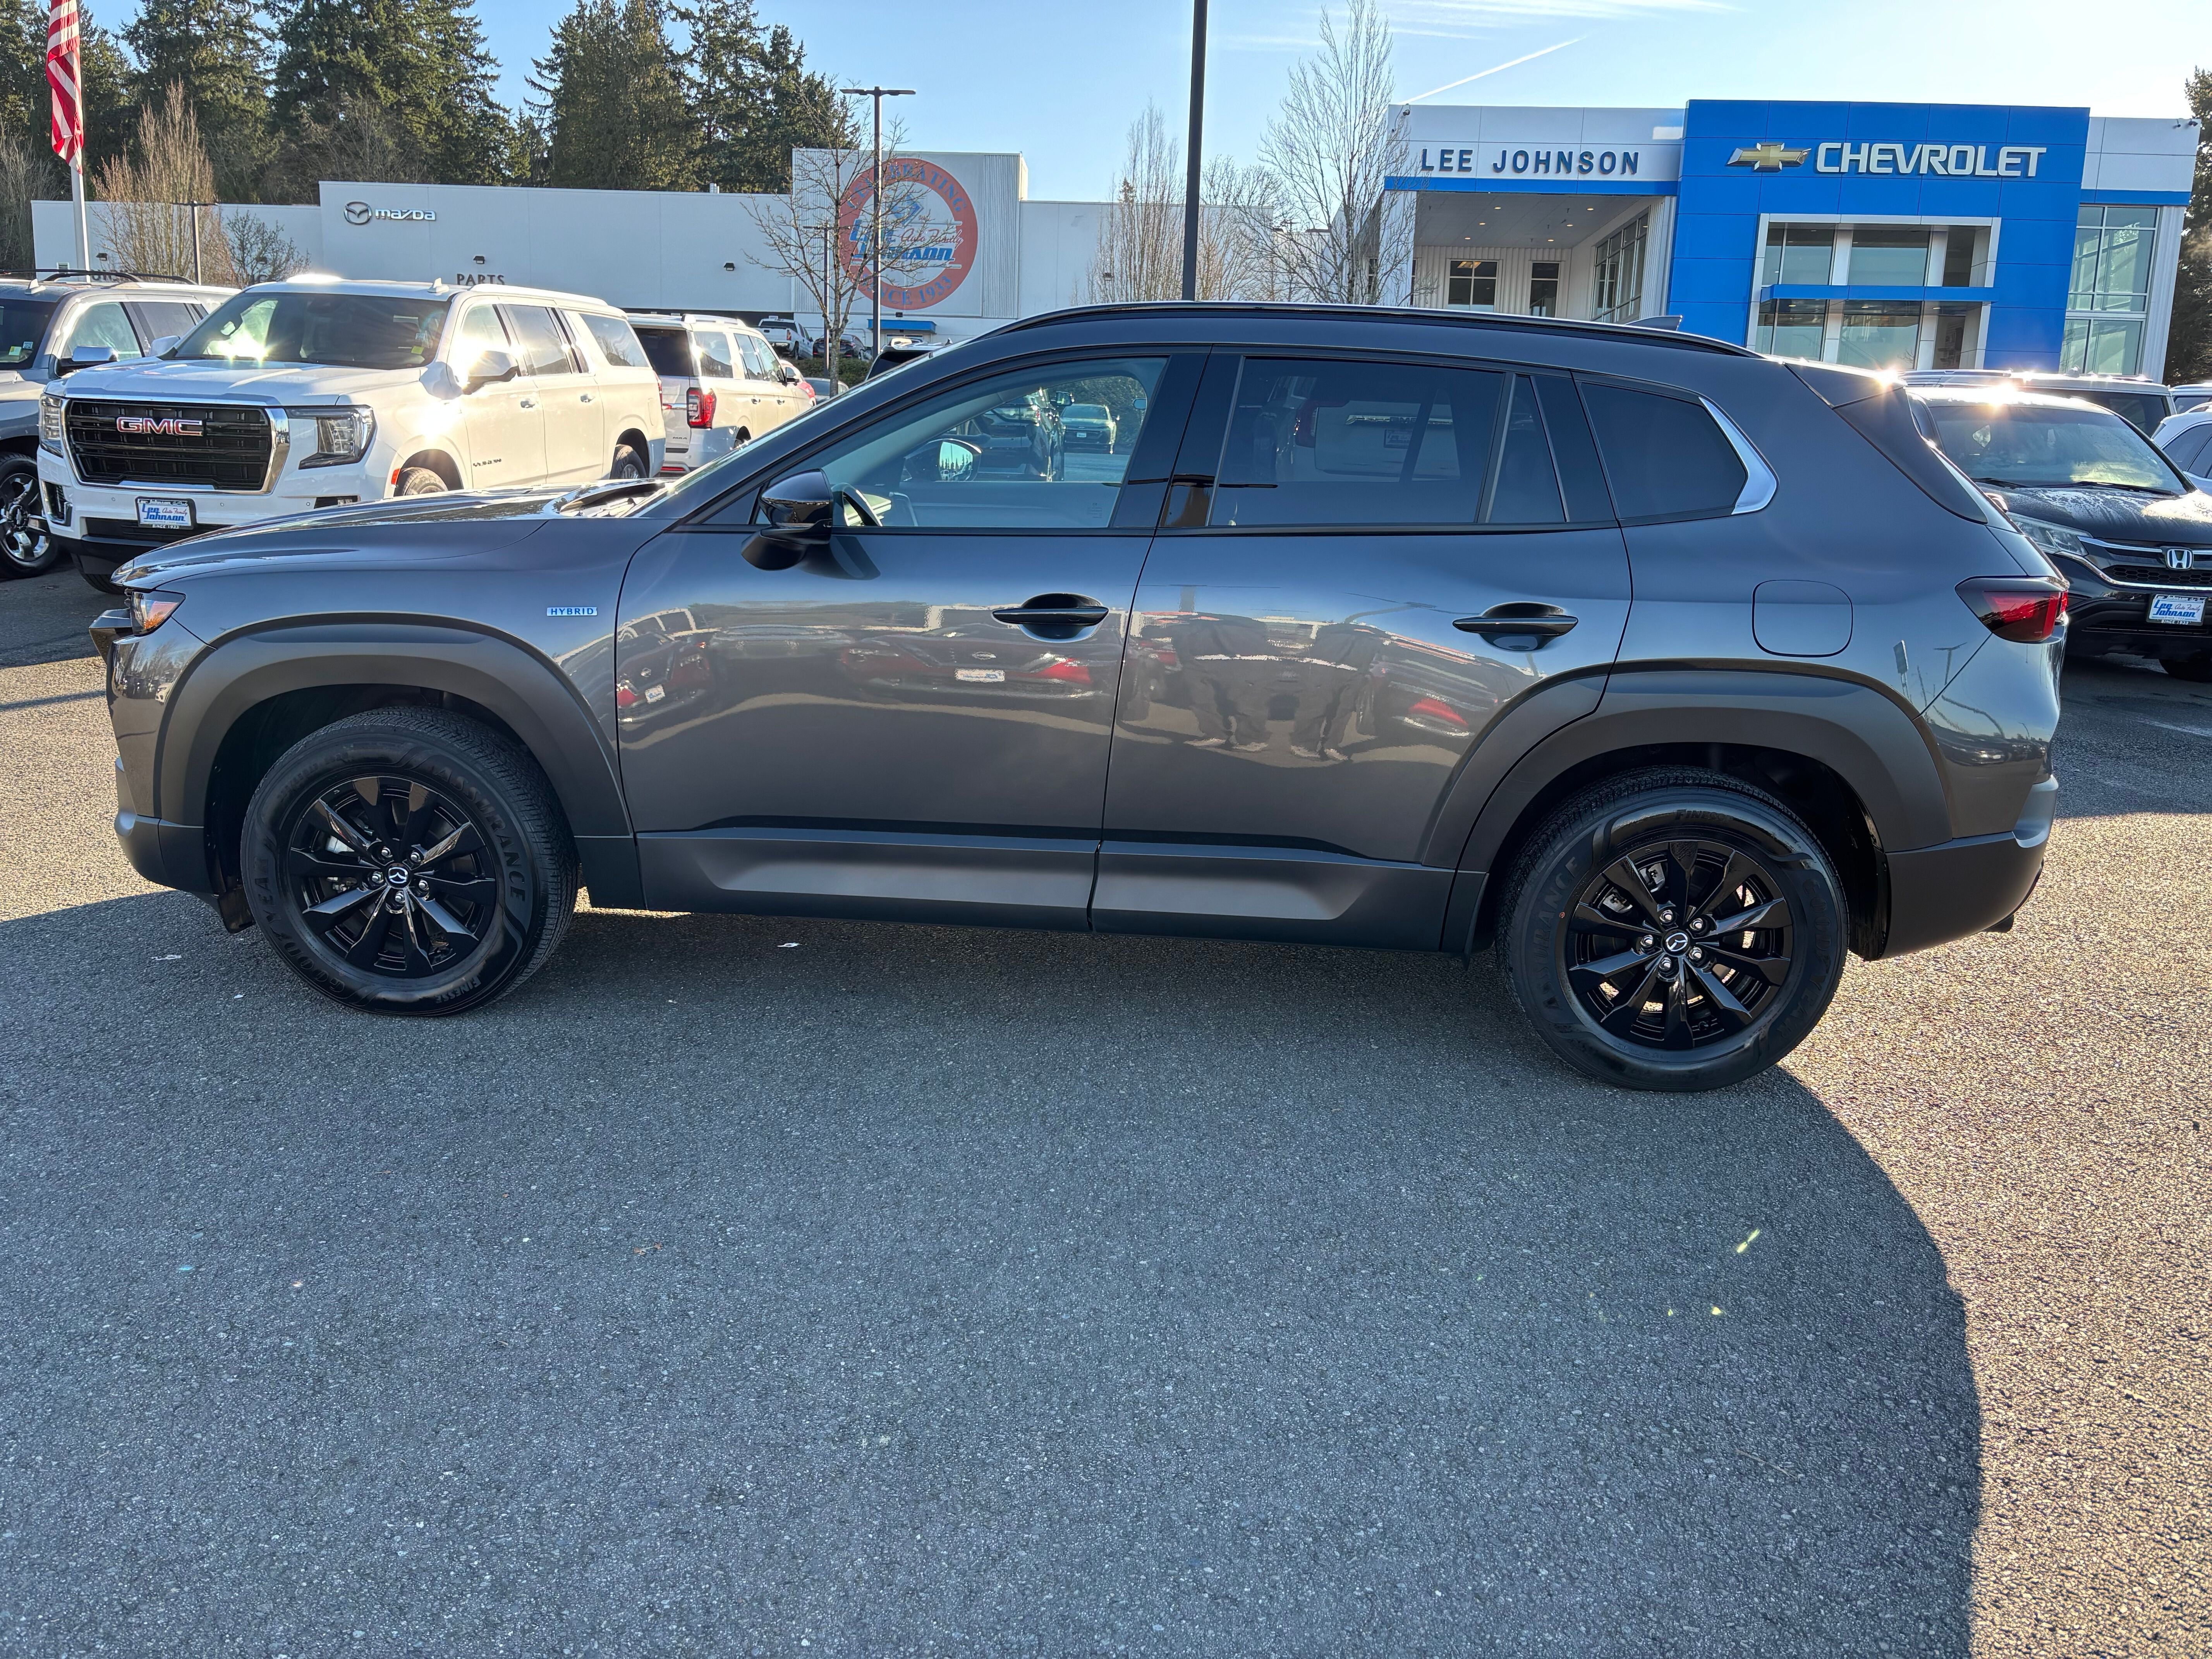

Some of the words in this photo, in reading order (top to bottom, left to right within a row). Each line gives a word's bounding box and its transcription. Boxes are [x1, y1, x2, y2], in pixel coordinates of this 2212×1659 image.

[1422, 148, 1474, 172] LEE
[1492, 149, 1639, 175] JOHNSON
[1816, 142, 2047, 177] CHEVROLET
[847, 164, 967, 211] CELBRATING
[457, 273, 505, 285] PARTS
[919, 275, 952, 303] 1933
[117, 417, 203, 436] GMC
[142, 503, 160, 513] Lee
[143, 511, 186, 521] Johnson
[2153, 608, 2195, 618] Johnson
[2154, 600, 2172, 610] Lee
[1675, 809, 1733, 822] FINESSE
[434, 765, 526, 903] ASSURANCE
[252, 857, 345, 998] GOODYEAR
[1533, 857, 1585, 1010] ASSURANCE
[1777, 879, 1834, 1042] GOODYEAR
[436, 976, 482, 1004] FINESSE
